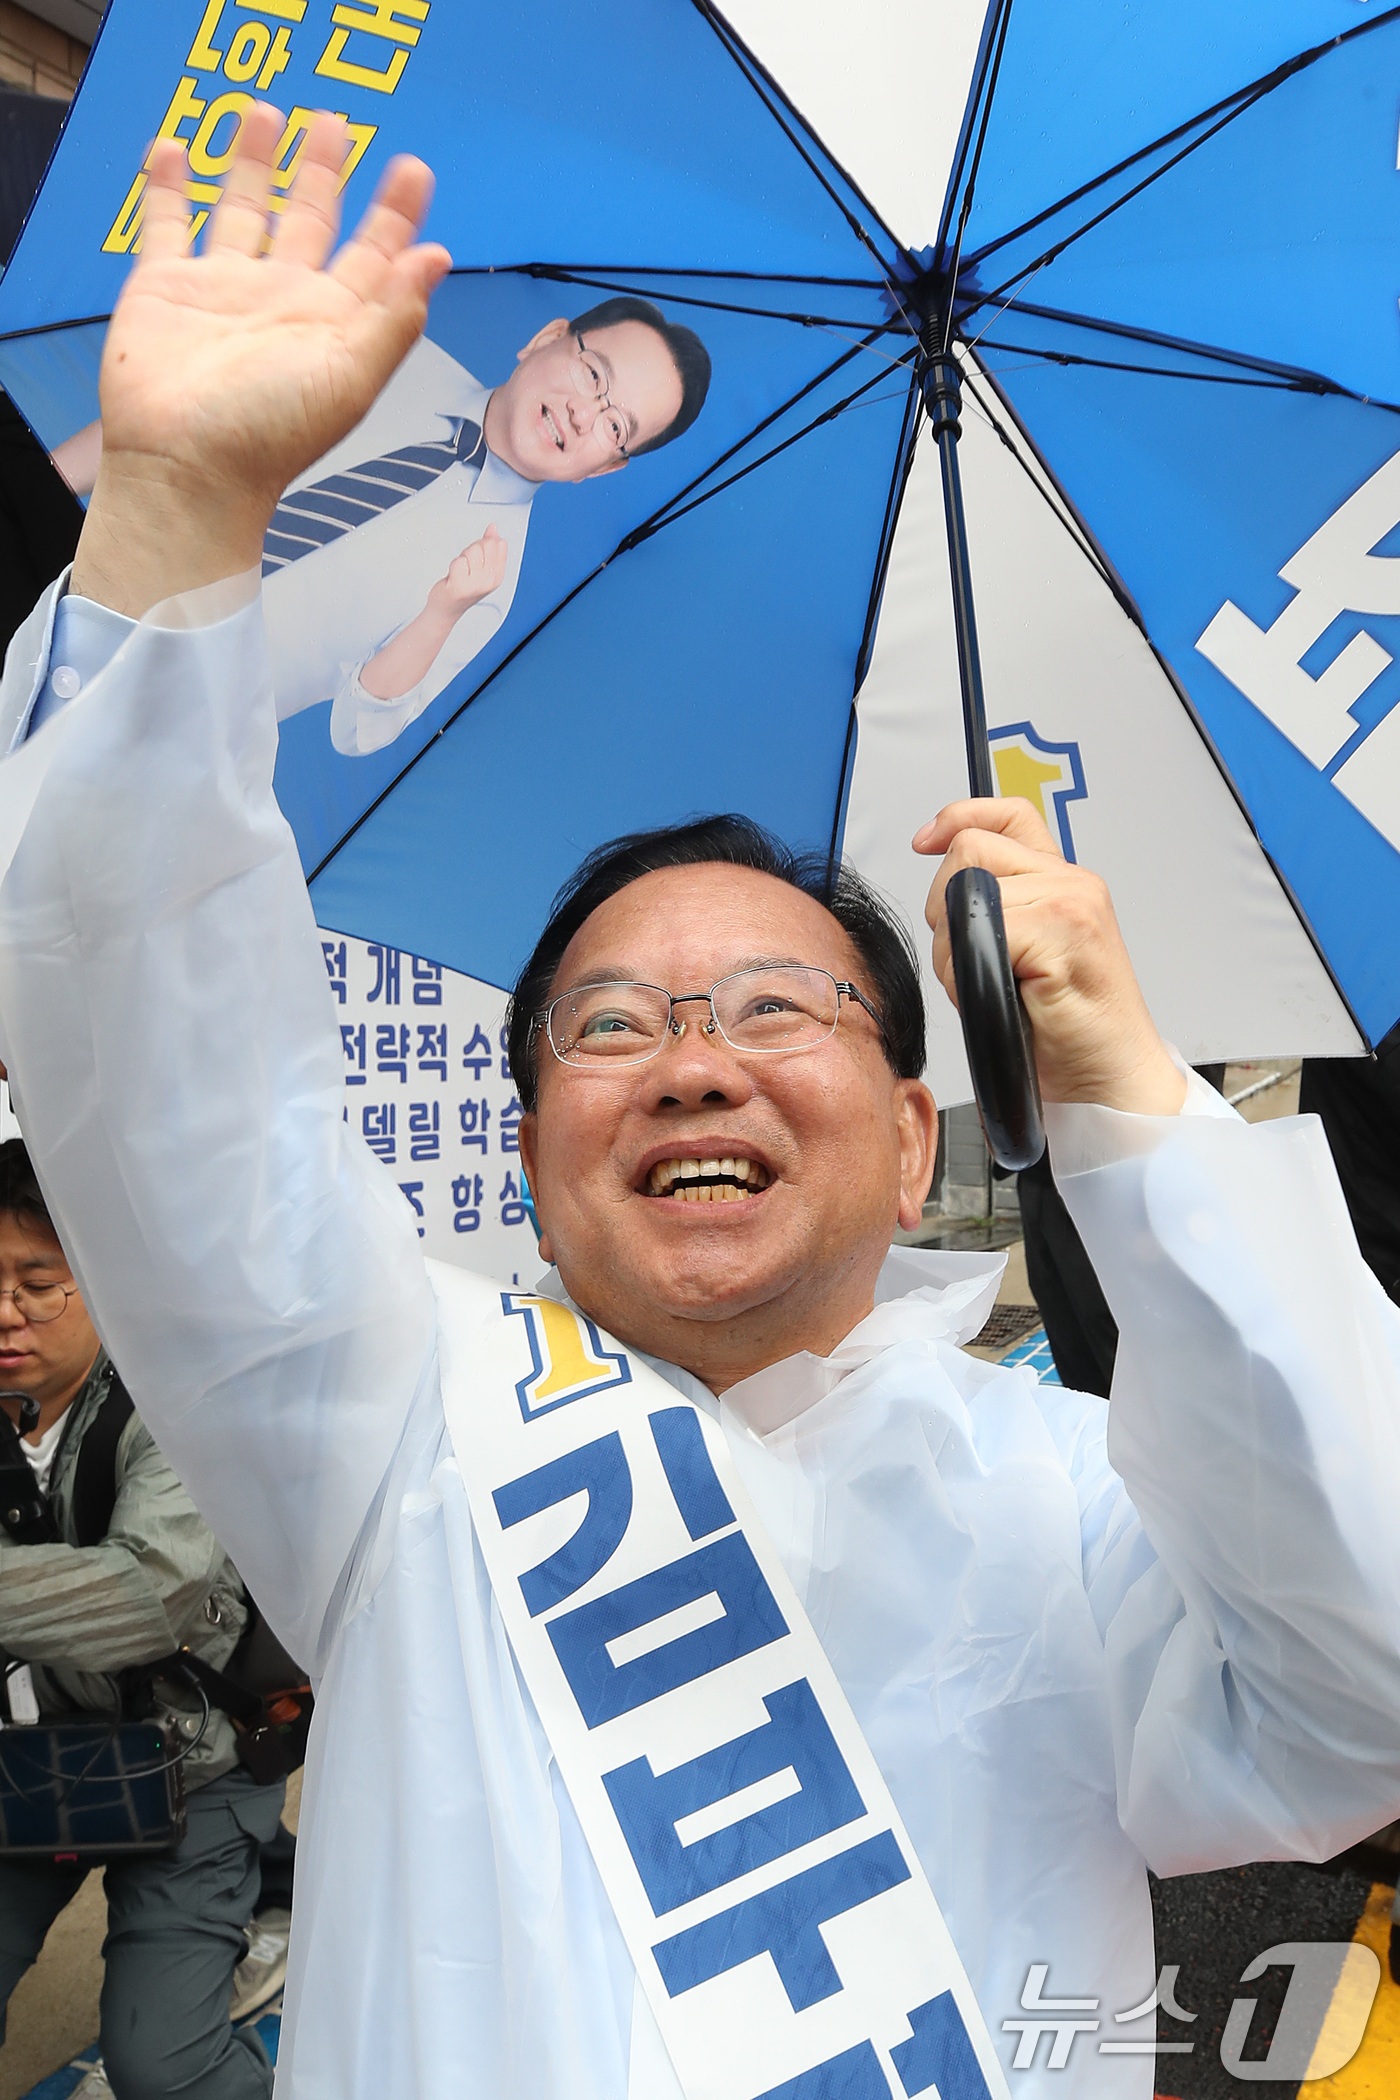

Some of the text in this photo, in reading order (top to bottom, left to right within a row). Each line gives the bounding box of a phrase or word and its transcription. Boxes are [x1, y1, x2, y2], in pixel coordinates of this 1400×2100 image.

[339, 1023, 447, 1085] 전략적
[343, 1096, 525, 1162] 델릴 학습
